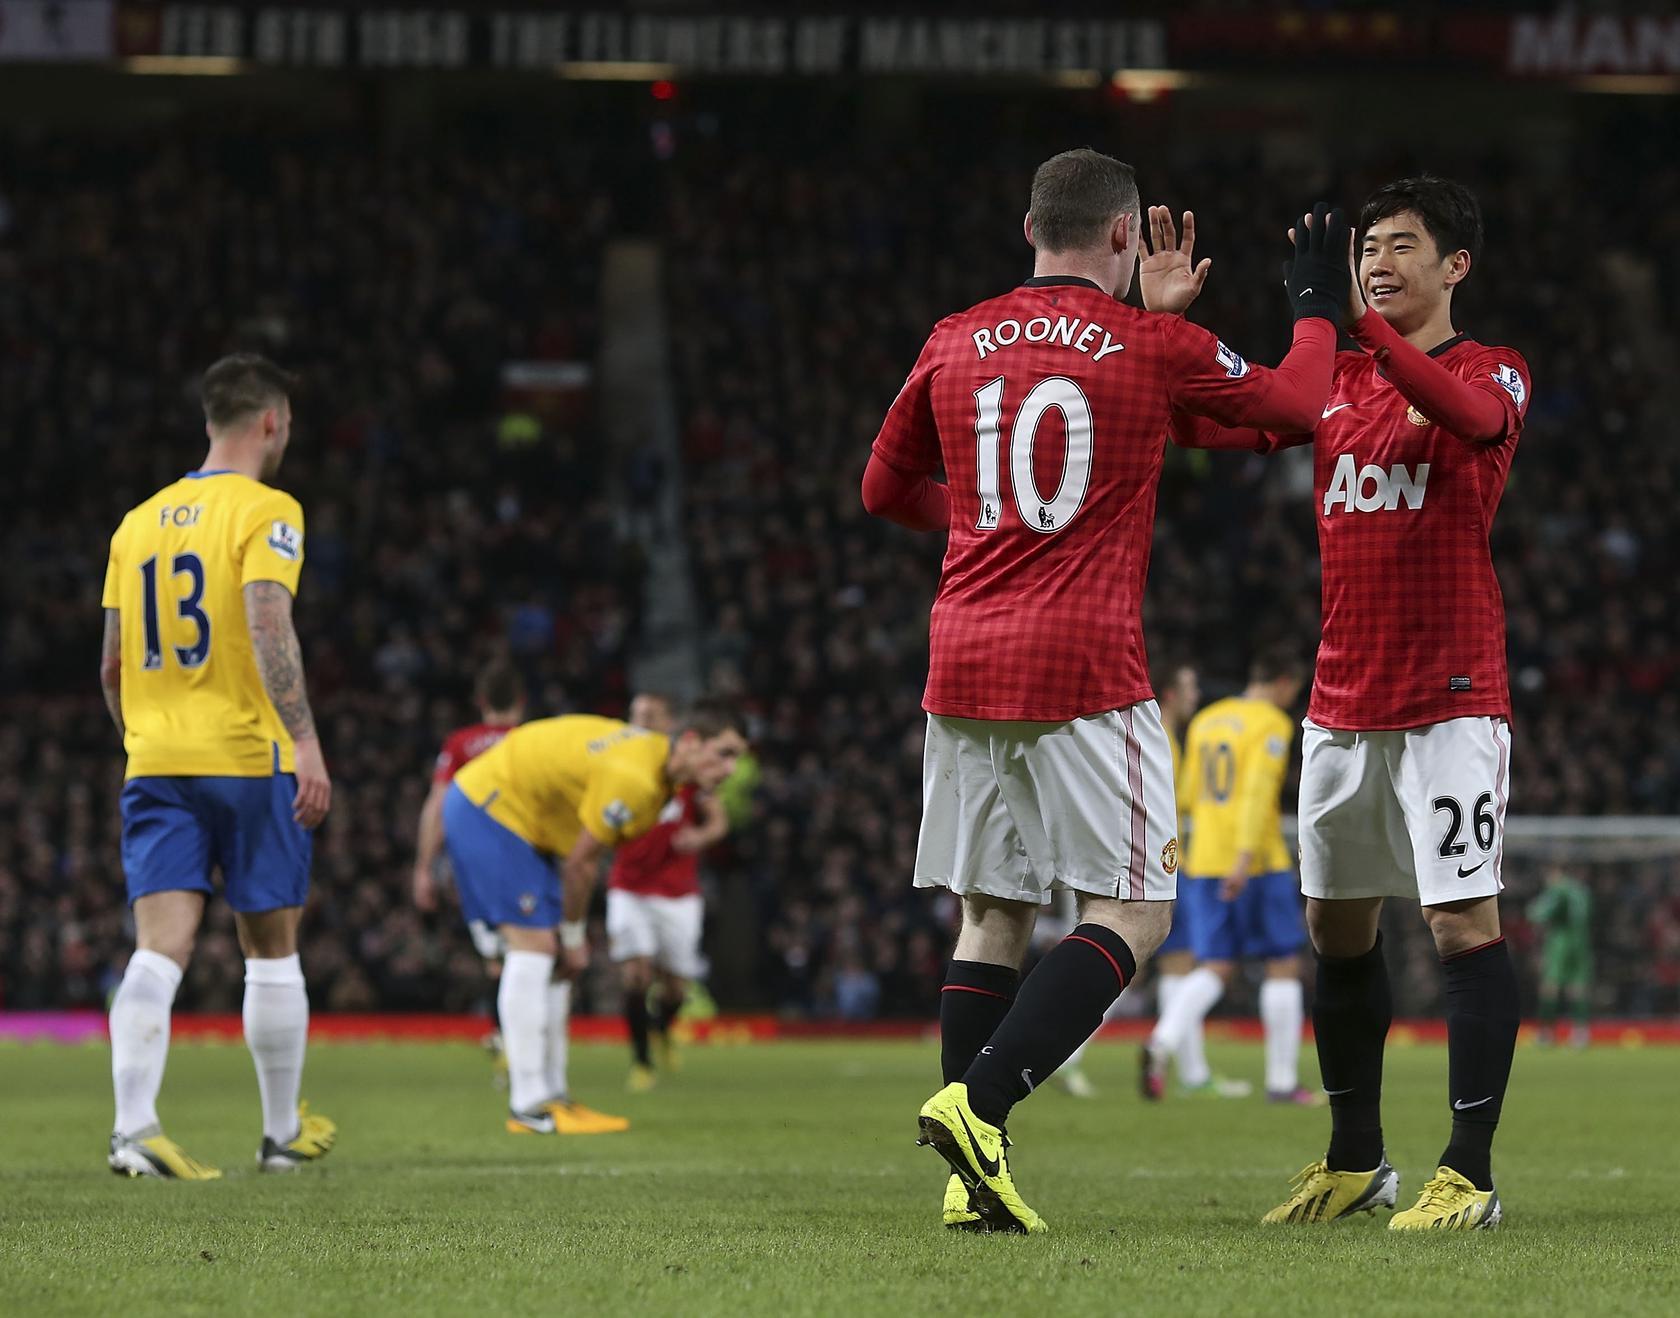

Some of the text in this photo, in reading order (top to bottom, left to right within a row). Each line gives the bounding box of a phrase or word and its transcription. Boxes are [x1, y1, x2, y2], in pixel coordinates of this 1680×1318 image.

[858, 17, 1166, 71] MANCHESTER
[971, 315, 1125, 362] ROONEY
[973, 375, 1094, 533] 10
[1323, 454, 1431, 516] AON
[140, 551, 211, 670] 13
[1431, 791, 1497, 860] 26
